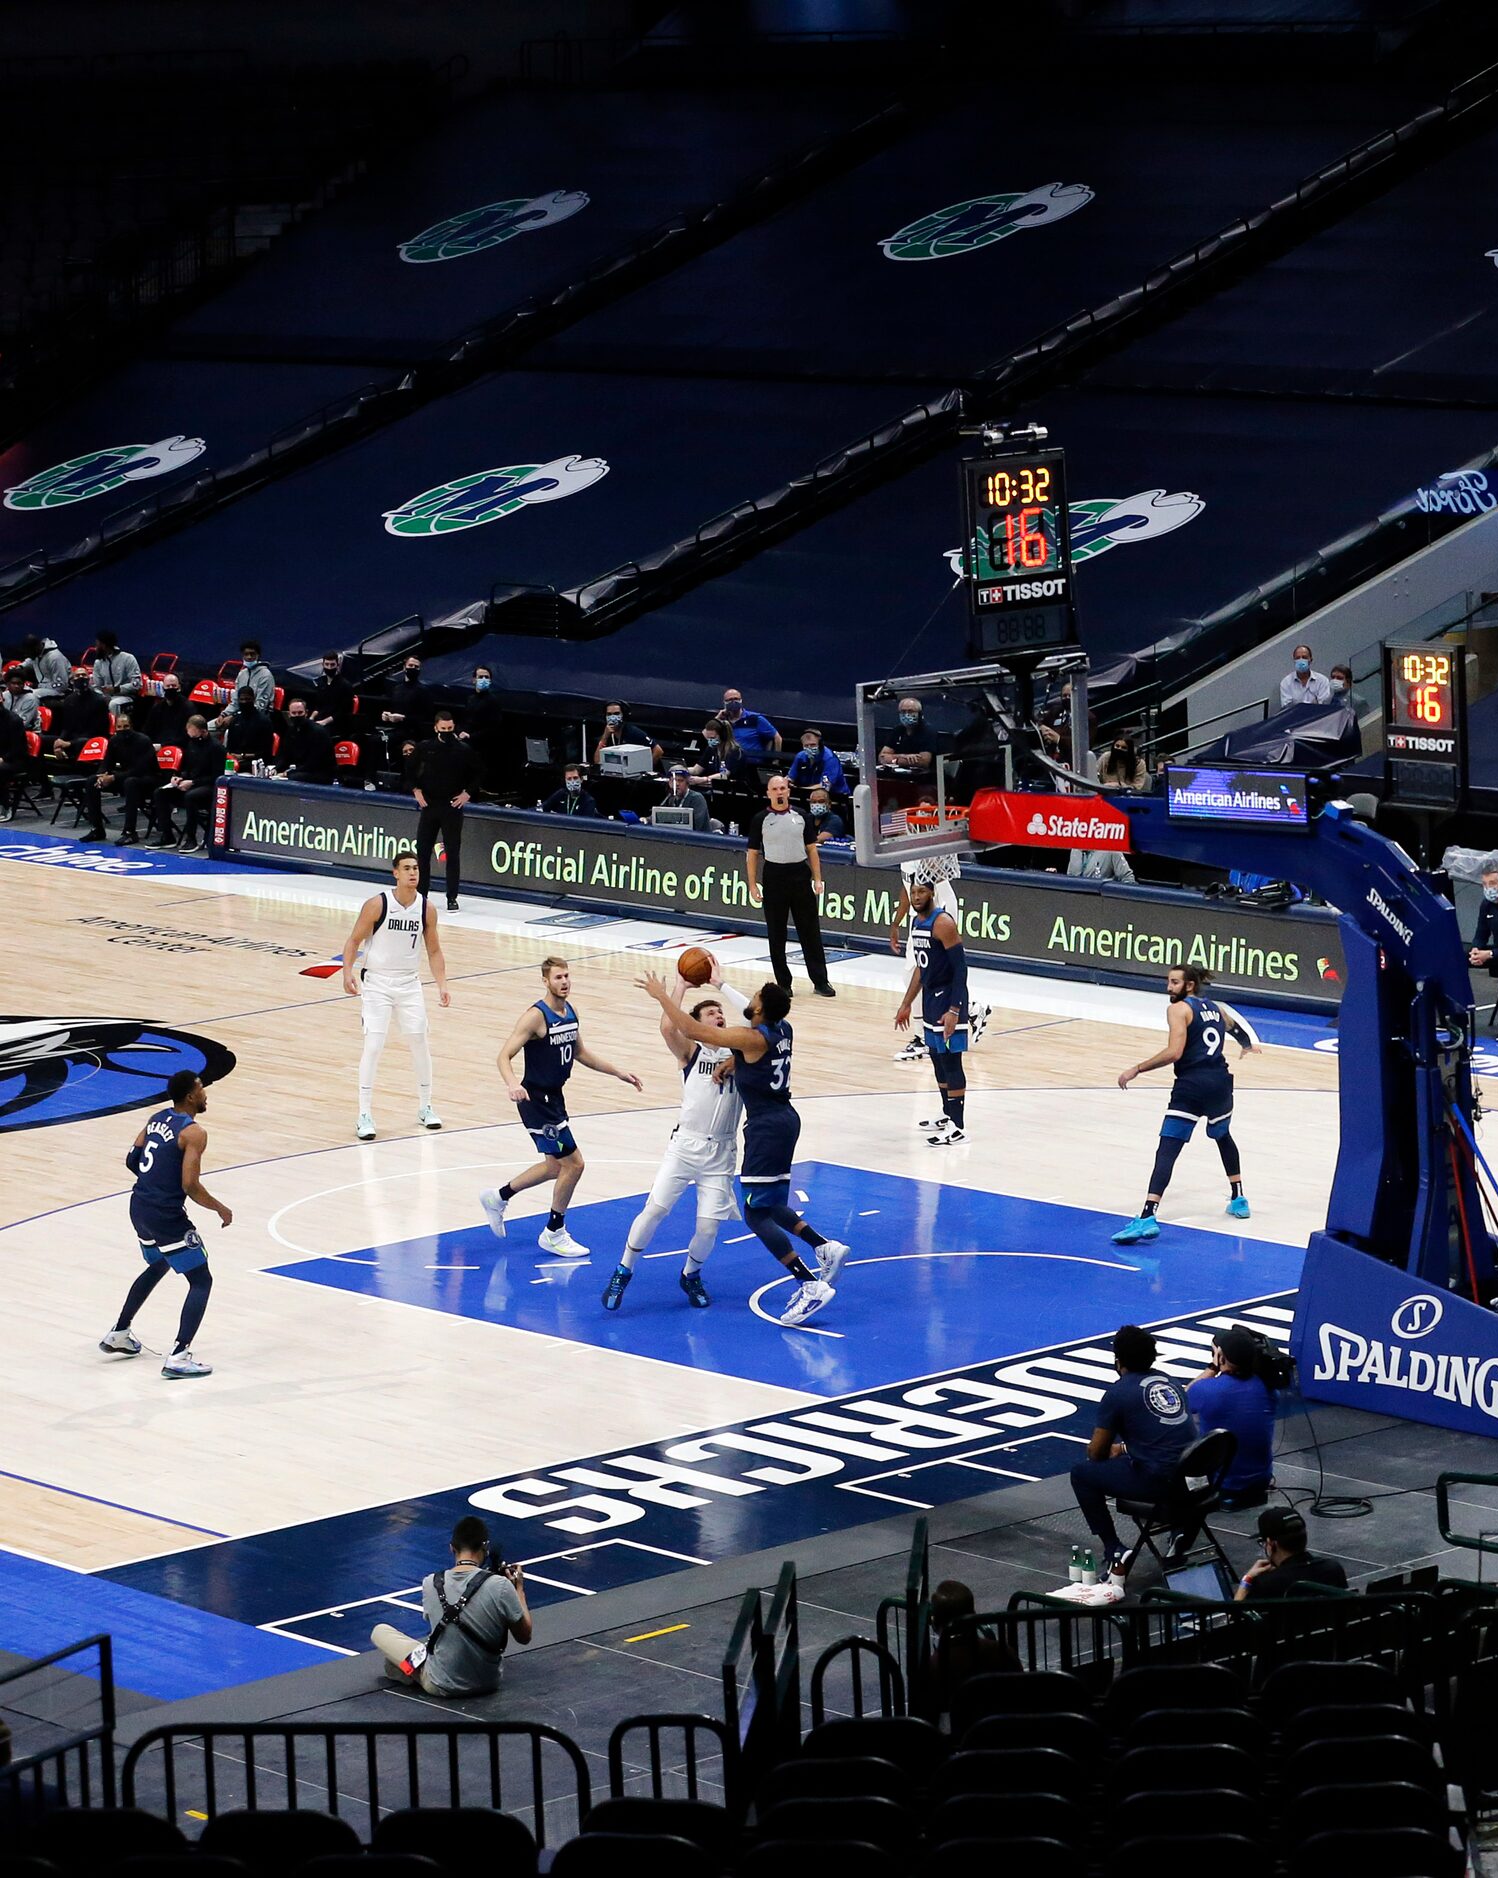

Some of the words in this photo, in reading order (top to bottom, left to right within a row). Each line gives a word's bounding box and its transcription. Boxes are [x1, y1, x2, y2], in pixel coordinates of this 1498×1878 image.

[988, 467, 1050, 506] 10:32
[1006, 507, 1047, 567] 16
[1003, 578, 1067, 602] TISSOT
[1403, 655, 1449, 685] 10:32
[1416, 686, 1441, 722] 16
[1406, 737, 1455, 752] TISSOT
[1174, 788, 1233, 808] American
[1232, 790, 1281, 811] Airlines
[243, 811, 339, 852] American
[490, 840, 585, 883] Official
[590, 853, 678, 897] Airline
[684, 866, 715, 901] of
[388, 918, 420, 932] DALLAS
[1366, 887, 1414, 948] SPALDING
[66, 916, 208, 940] American
[204, 935, 318, 958] Airlines
[106, 935, 212, 955] Center
[410, 933, 418, 949] 7
[1047, 916, 1183, 965] American
[1187, 934, 1299, 981] Airlines
[560, 1044, 572, 1066] 10
[1202, 1026, 1220, 1056] 9
[146, 1121, 175, 1143] BEASLEY
[138, 1140, 160, 1174] 5
